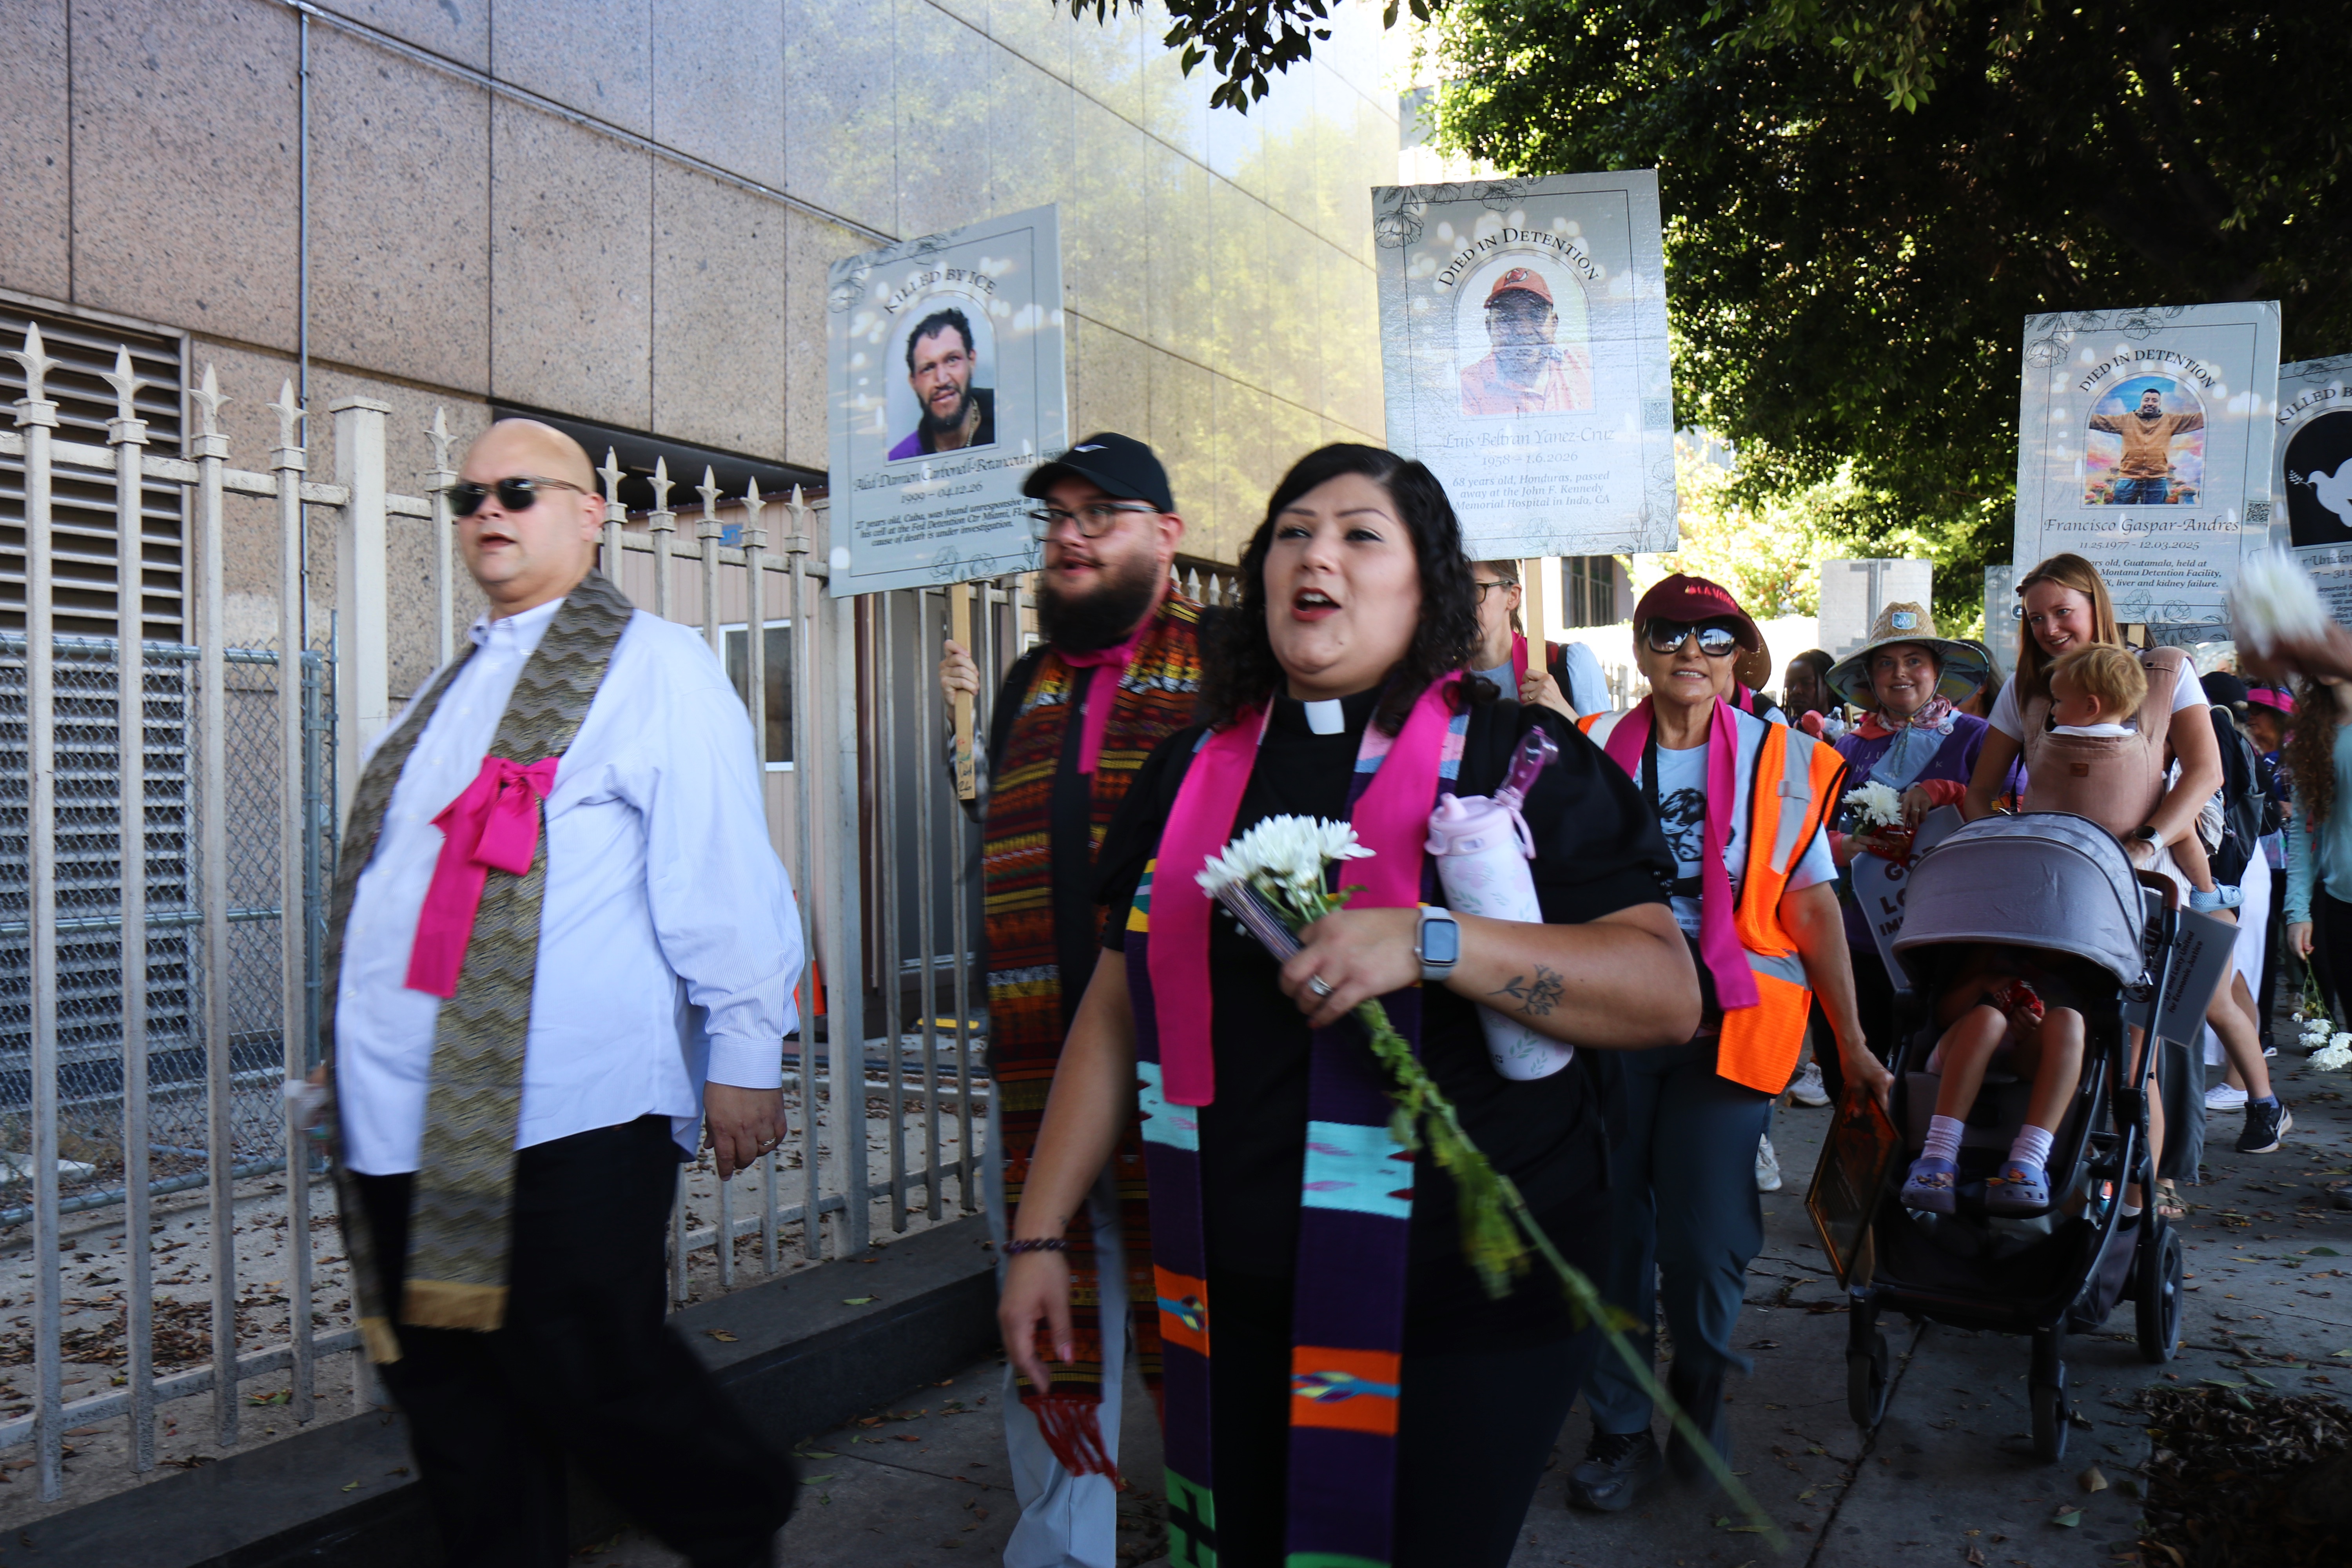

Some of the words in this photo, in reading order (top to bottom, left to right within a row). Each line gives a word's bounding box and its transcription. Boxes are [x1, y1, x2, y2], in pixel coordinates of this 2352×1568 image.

[1437, 248, 1475, 287] DIED
[1476, 235, 1498, 252] IN
[1501, 227, 1599, 280] DETENTION
[884, 271, 940, 314] KILLED
[946, 269, 966, 281] BY
[968, 271, 996, 294] ICE
[2078, 362, 2111, 392] DIED
[2111, 352, 2130, 367] IN
[2134, 349, 2216, 388] DETENTION
[2276, 388, 2336, 426] KILLED
[2342, 387, 2352, 397] B
[1477, 428, 1530, 446] Beltran
[1535, 427, 1615, 444] Yanez-Cruz
[1482, 454, 1510, 468] 1958
[1526, 450, 1578, 464] 1.6.2026
[1452, 477, 1465, 487] 68
[1468, 478, 1495, 488] years
[1497, 474, 1516, 486] old,
[1520, 473, 1573, 484] Honduras,
[1575, 471, 1610, 484] passed
[901, 492, 926, 505] 1999
[937, 482, 983, 498] 04.12.26
[1460, 490, 1486, 499] away
[1490, 488, 1500, 497] at
[1503, 486, 1519, 496] the
[1521, 486, 1545, 497] John
[1548, 485, 1557, 494] F.
[1560, 483, 1604, 494] Kennedy
[1455, 499, 1504, 510] Memorial
[1507, 496, 1550, 508] Hospital
[1595, 494, 1610, 504] CA
[866, 519, 886, 530] years
[2043, 518, 2116, 531] Francisco
[2121, 515, 2239, 537] Gaspar-Andres
[2079, 541, 2130, 550] 11.25.1977
[2139, 541, 2200, 550] 12.03.2025
[2105, 559, 2121, 568] old,
[2123, 559, 2174, 568] Guatamala,
[2186, 569, 2222, 578] Facility,
[2156, 579, 2185, 588] kidney
[2185, 579, 2219, 588] failure.
